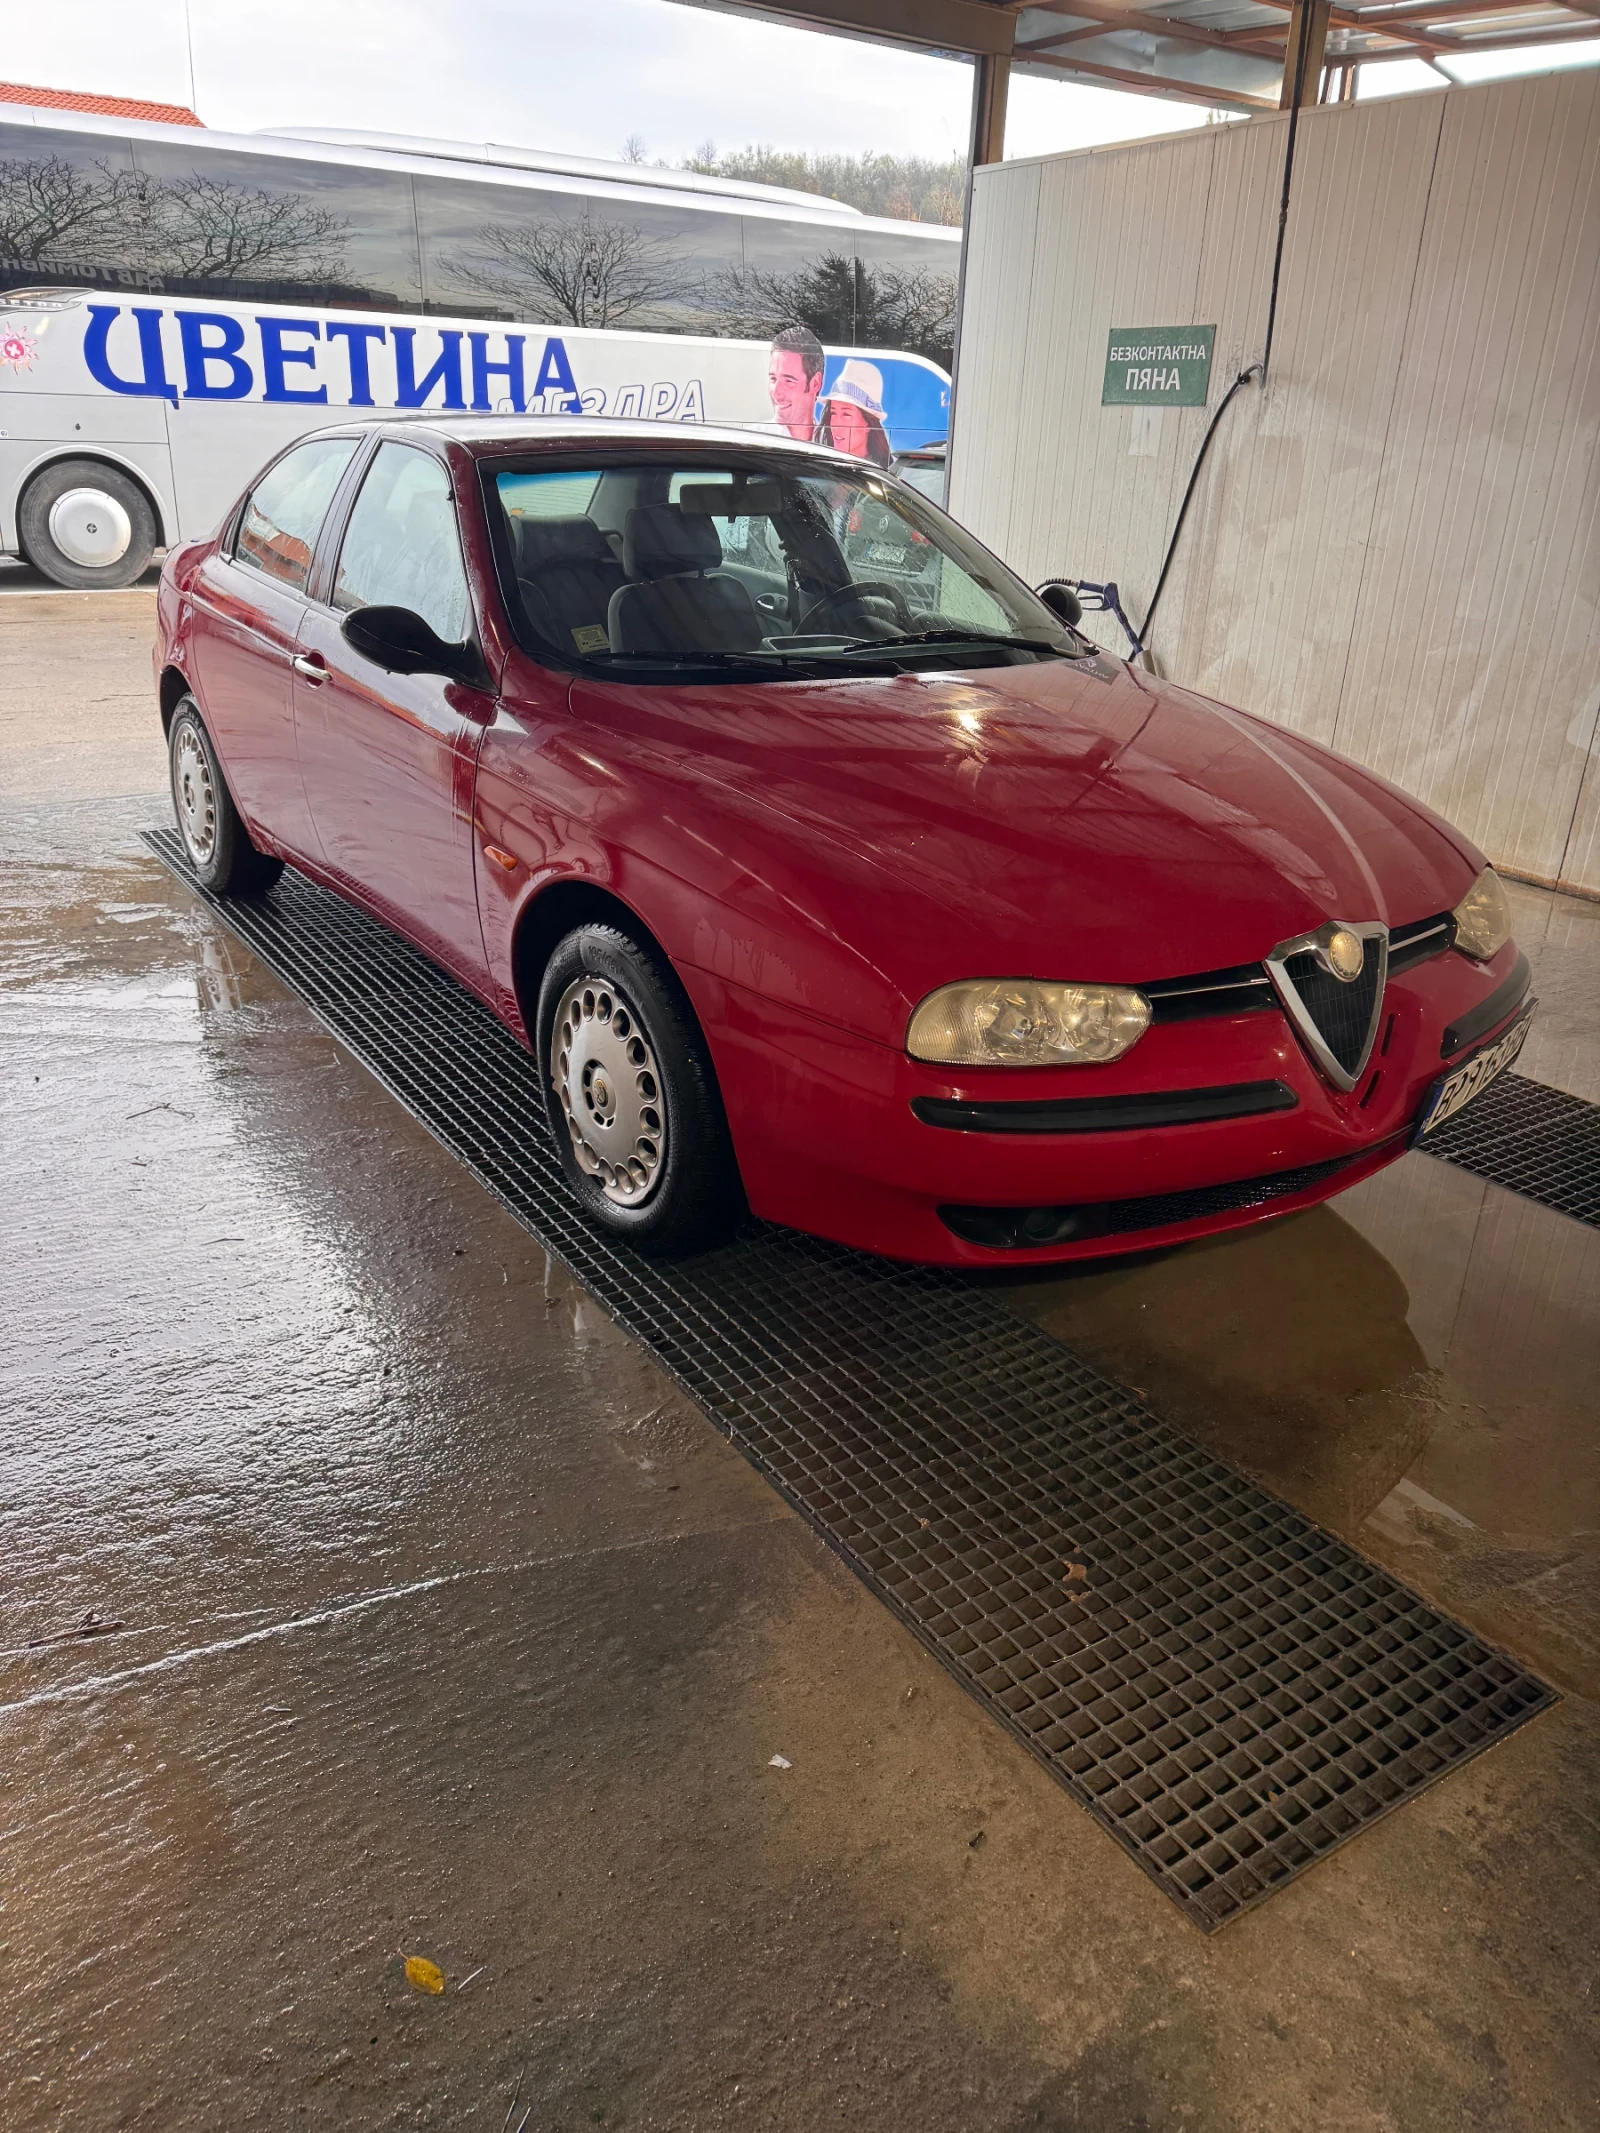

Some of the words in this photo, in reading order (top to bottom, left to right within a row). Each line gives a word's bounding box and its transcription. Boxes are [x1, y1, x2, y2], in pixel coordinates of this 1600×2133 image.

[83, 305, 584, 413] ЦВЕТИНА
[1110, 345, 1206, 361] БЕЗКОНТАКТНА
[1125, 368, 1180, 391] ПЯНА
